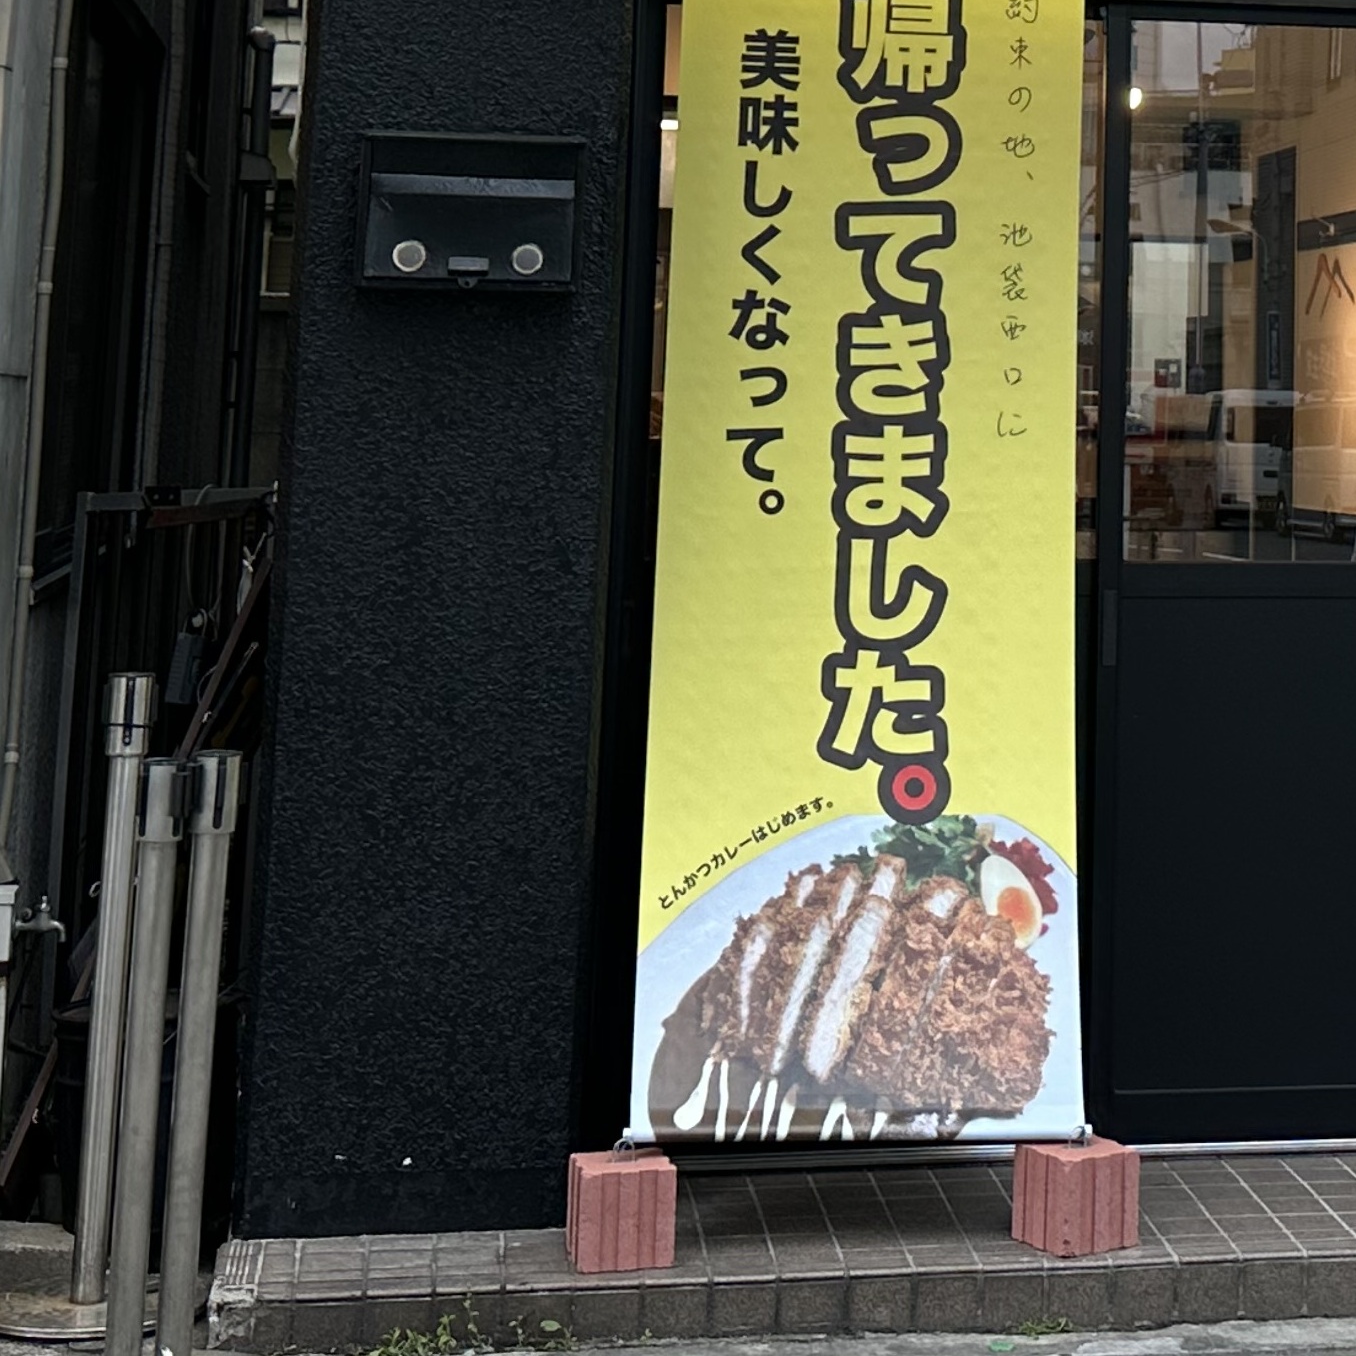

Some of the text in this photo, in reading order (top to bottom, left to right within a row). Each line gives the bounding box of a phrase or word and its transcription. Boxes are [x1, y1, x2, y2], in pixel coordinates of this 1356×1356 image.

[726, 29, 801, 515] 美味しくなって。
[658, 797, 834, 910] とんかつカレーはじめます。
